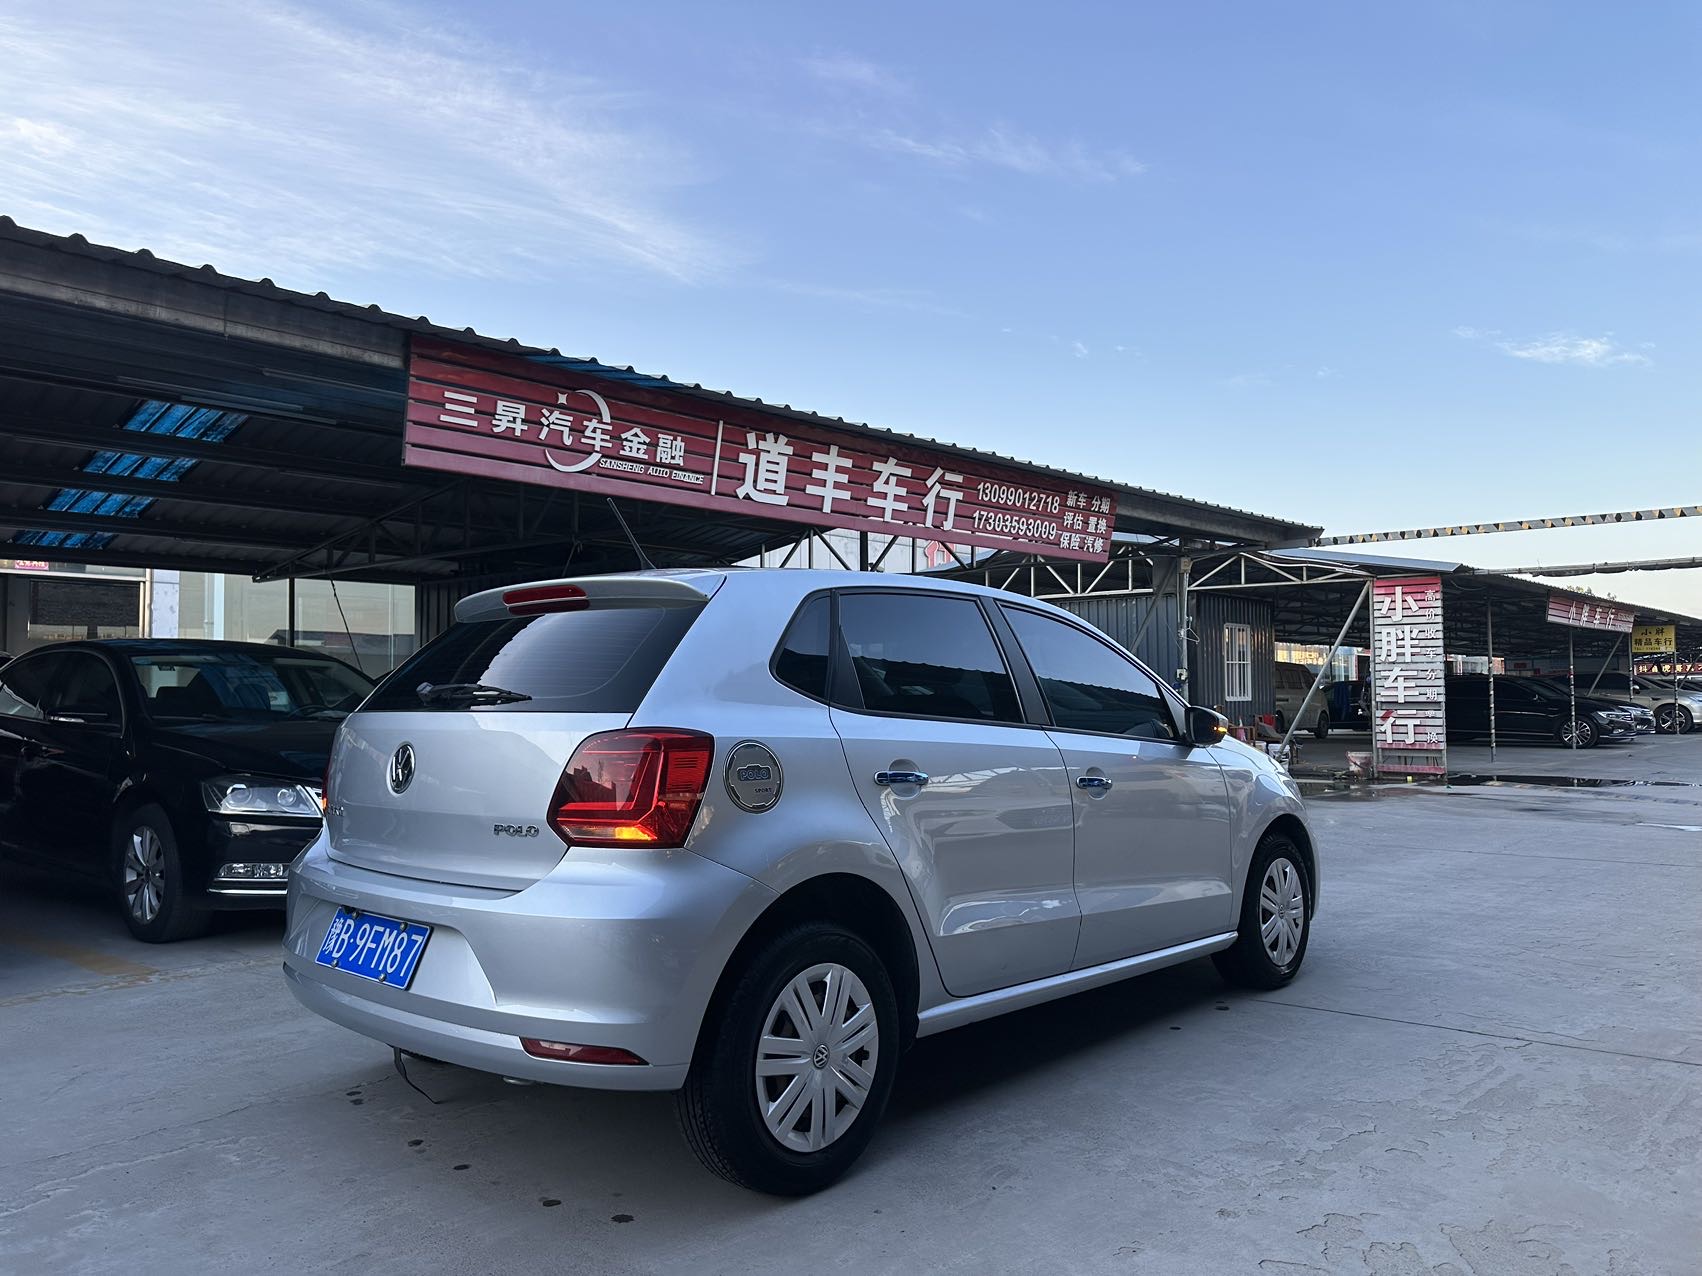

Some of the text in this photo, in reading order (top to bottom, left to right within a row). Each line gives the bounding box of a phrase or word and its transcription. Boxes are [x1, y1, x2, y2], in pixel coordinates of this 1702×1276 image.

[439, 391, 685, 466] 三昇汽车金融
[599, 458, 645, 474] SANSHENG
[647, 466, 670, 478] AUTO
[735, 432, 964, 531] 道丰车行
[977, 482, 1060, 514] 13099012718
[1066, 490, 1110, 514] 新车 分期
[972, 510, 1057, 540] 17303593009
[1063, 511, 1107, 534] 评估 置换
[1060, 532, 1104, 553] 保险 汽修
[1379, 586, 1421, 745] 小胖车行
[740, 769, 769, 780] POLO
[493, 824, 540, 838] POLO
